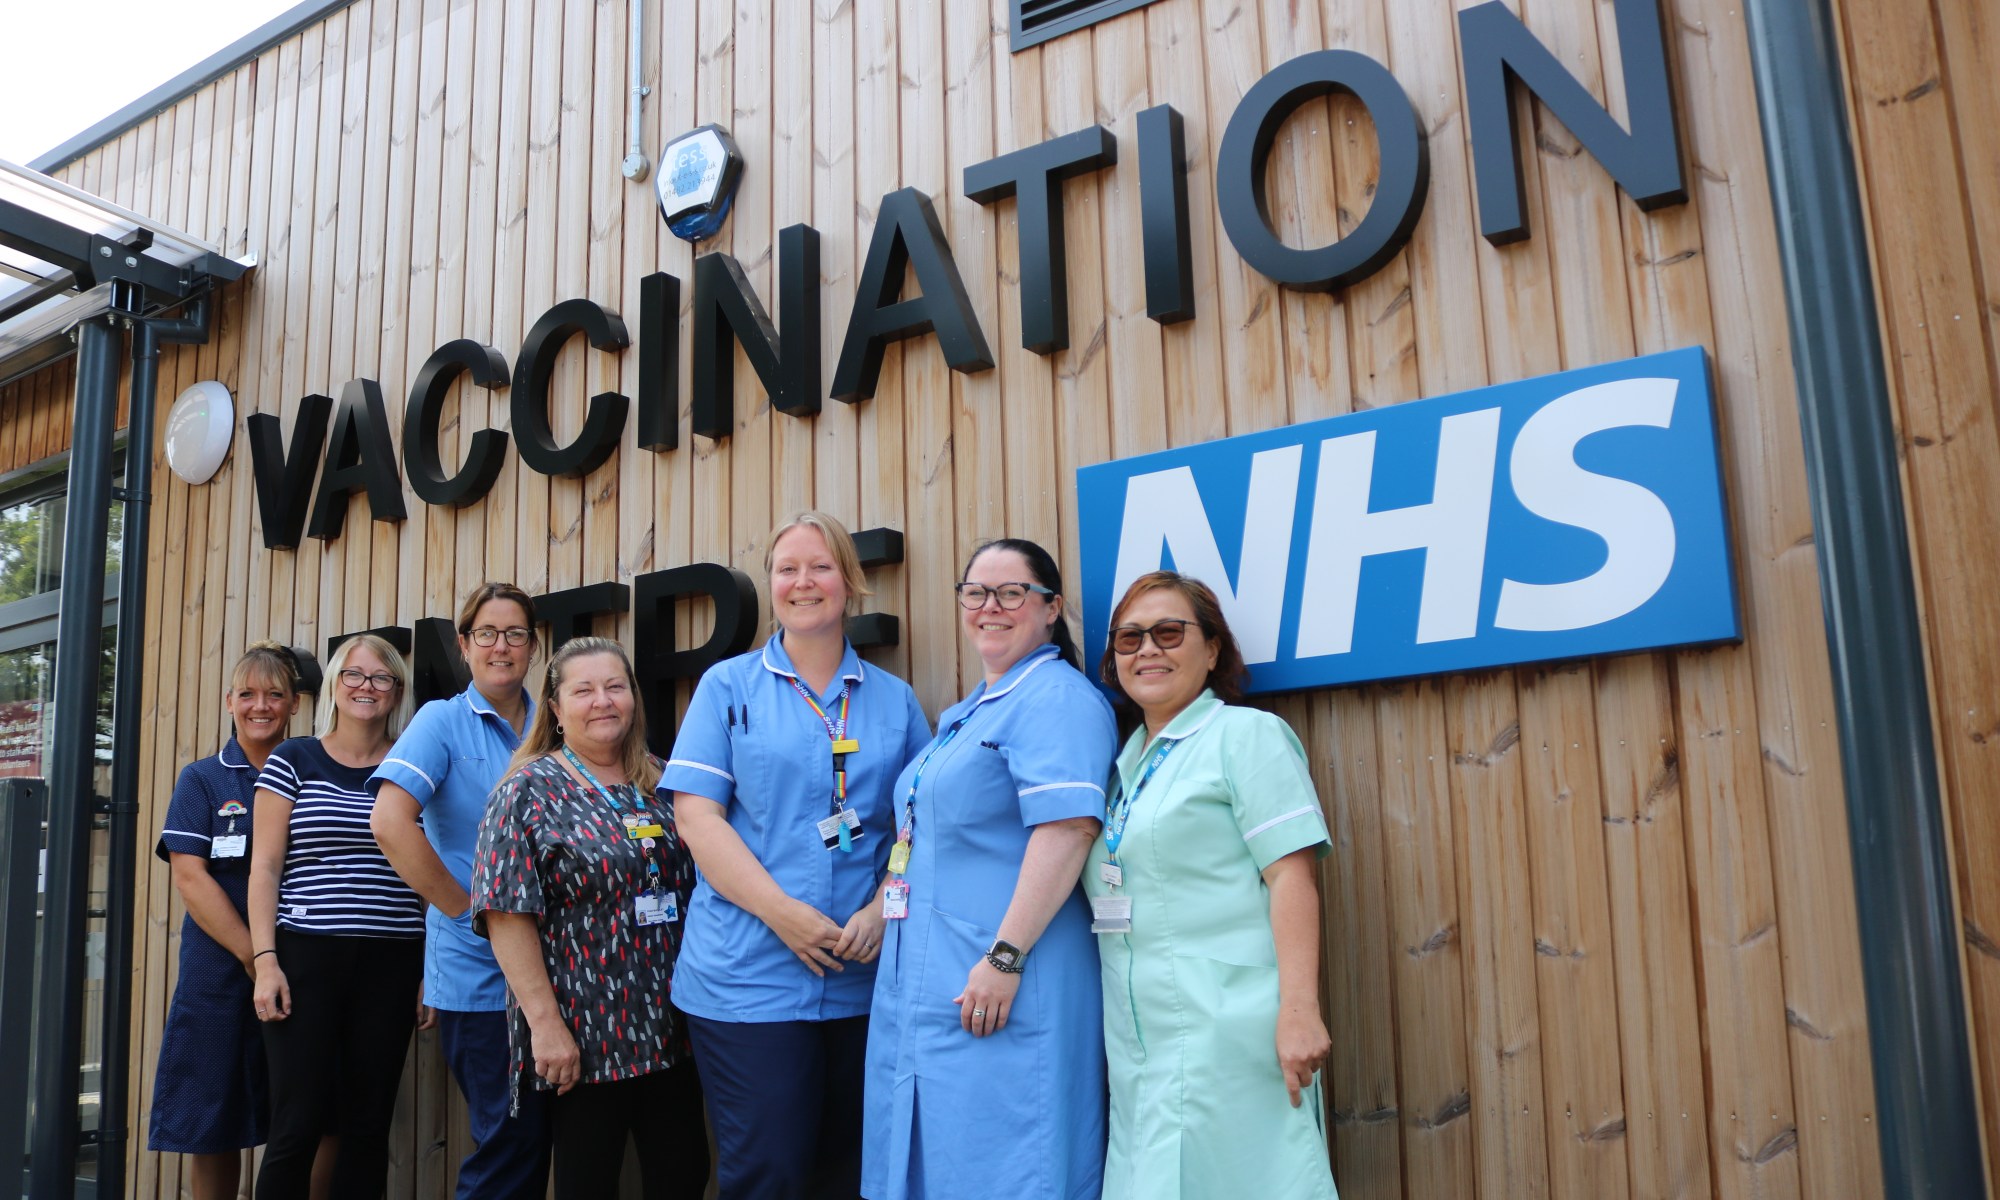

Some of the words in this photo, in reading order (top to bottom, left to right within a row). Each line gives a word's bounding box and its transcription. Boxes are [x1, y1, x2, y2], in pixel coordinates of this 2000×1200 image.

[248, 0, 1688, 550] VACCINATION
[1105, 377, 1680, 665] NHS
[795, 681, 811, 698] NHS
[823, 716, 836, 735] NHS
[835, 718, 846, 735] NHS
[1152, 754, 1164, 769] NHS
